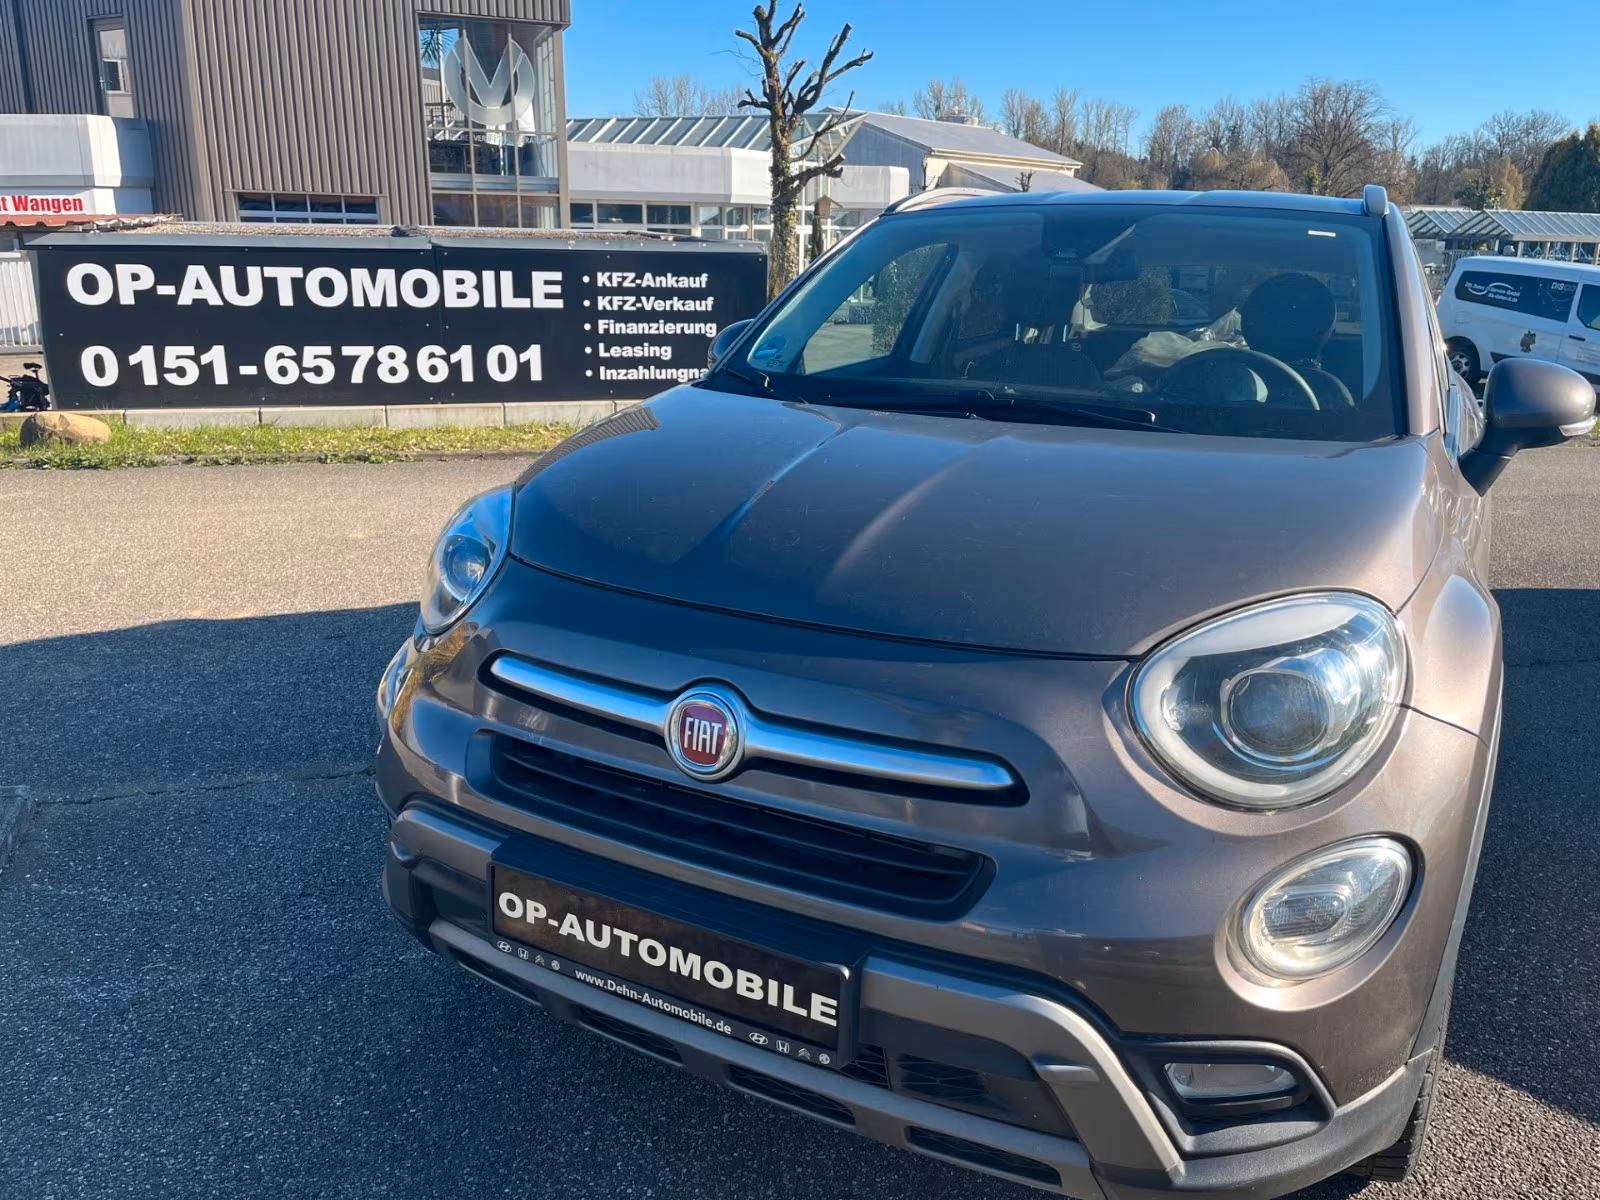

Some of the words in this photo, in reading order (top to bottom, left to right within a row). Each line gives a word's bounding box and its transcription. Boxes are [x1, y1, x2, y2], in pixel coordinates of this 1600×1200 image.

[12, 194, 84, 213] Wangen
[66, 262, 564, 309] OP-AUTOMOBILE
[596, 271, 709, 288] KFZ-Ankauf
[597, 295, 715, 311] KFZ-Verkauf
[597, 319, 717, 338] Finanzierung
[598, 342, 672, 360] Leasing
[683, 716, 722, 755] FIAT
[498, 892, 838, 1027] OP-AUTOMOBILE
[575, 969, 732, 1034] www.Dehn-Automobile.de
